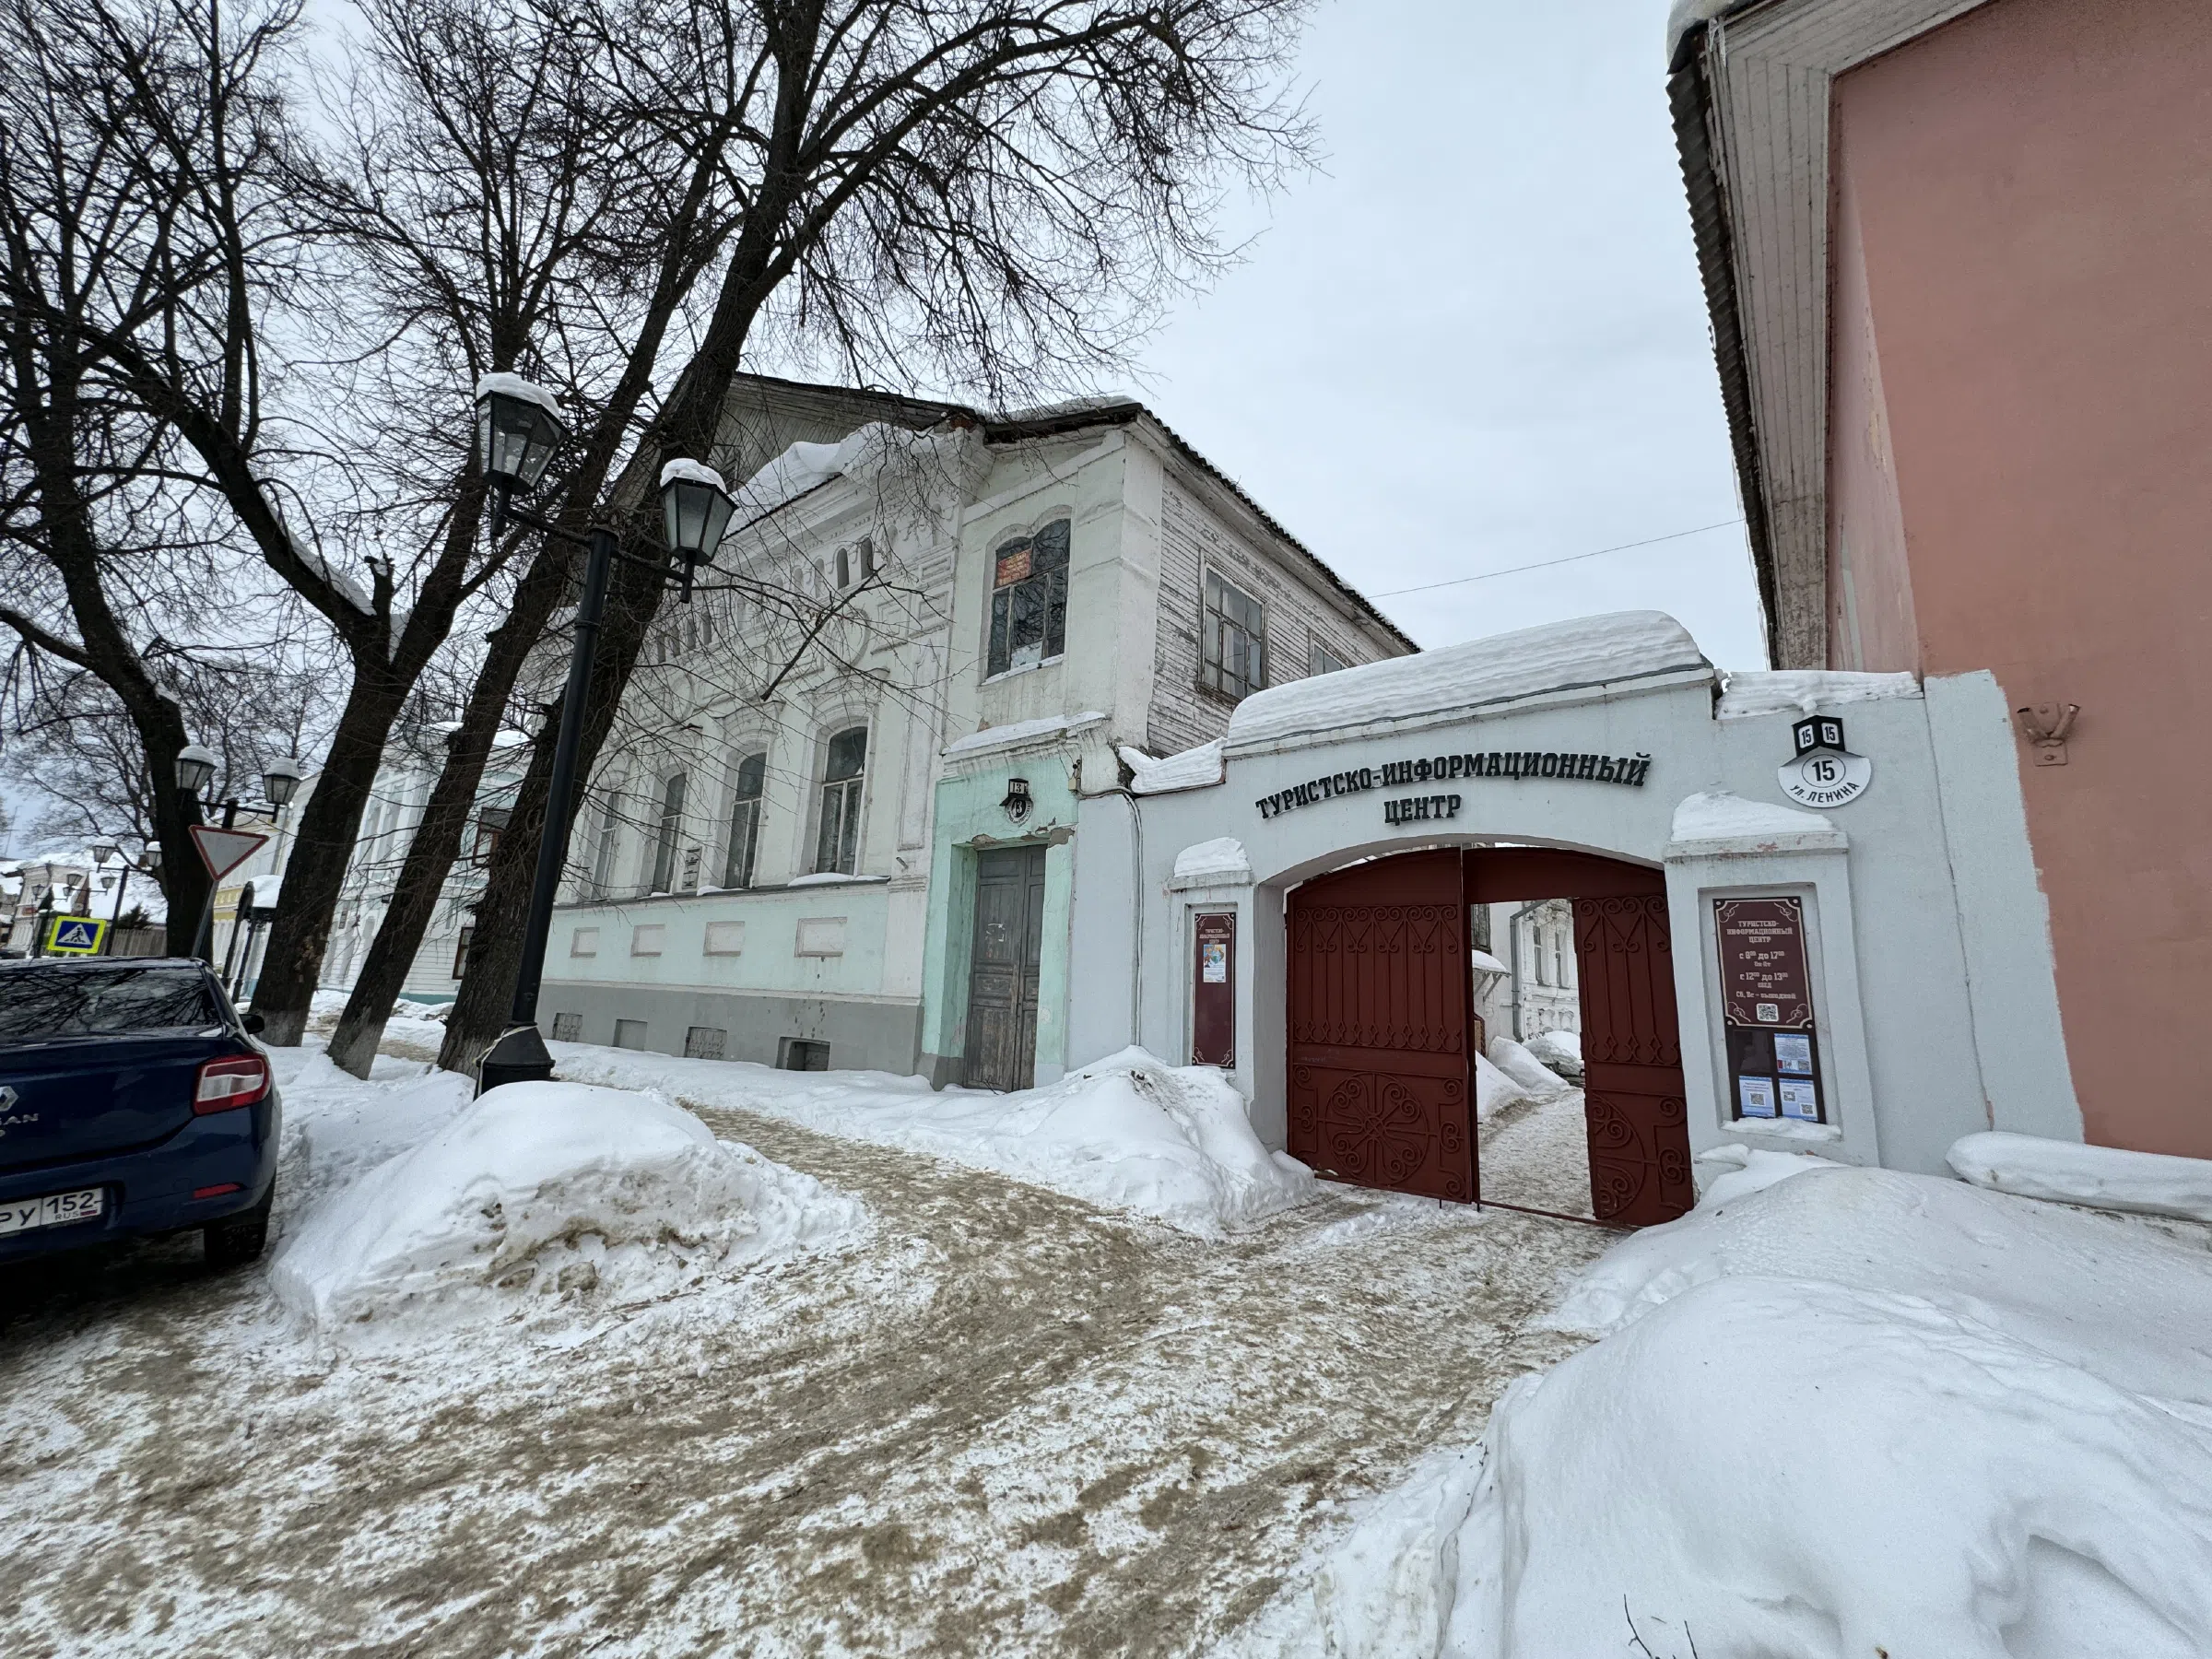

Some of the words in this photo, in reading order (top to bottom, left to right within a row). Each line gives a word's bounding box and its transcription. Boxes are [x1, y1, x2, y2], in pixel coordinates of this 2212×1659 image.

[1801, 728, 1813, 745] 15
[1824, 726, 1836, 741] 15
[1811, 759, 1835, 782] 15
[1013, 782, 1022, 793] 13
[1255, 751, 1651, 819] ТУРИСТСКО-ИНФОРМАЦИОННЫЙ
[1790, 784, 1805, 799] УЛ.
[1806, 782, 1860, 803] ЛЕНИНА
[1383, 794, 1463, 826] ЦЕНТР
[1726, 926, 1793, 935] ИНФОРМАЦИОННЫЙ
[1748, 935, 1771, 944] ЦЕНТР
[1758, 952, 1770, 960] до
[0, 1112, 39, 1125] AN
[46, 1192, 95, 1214] 152
[55, 1211, 80, 1221] RUS
